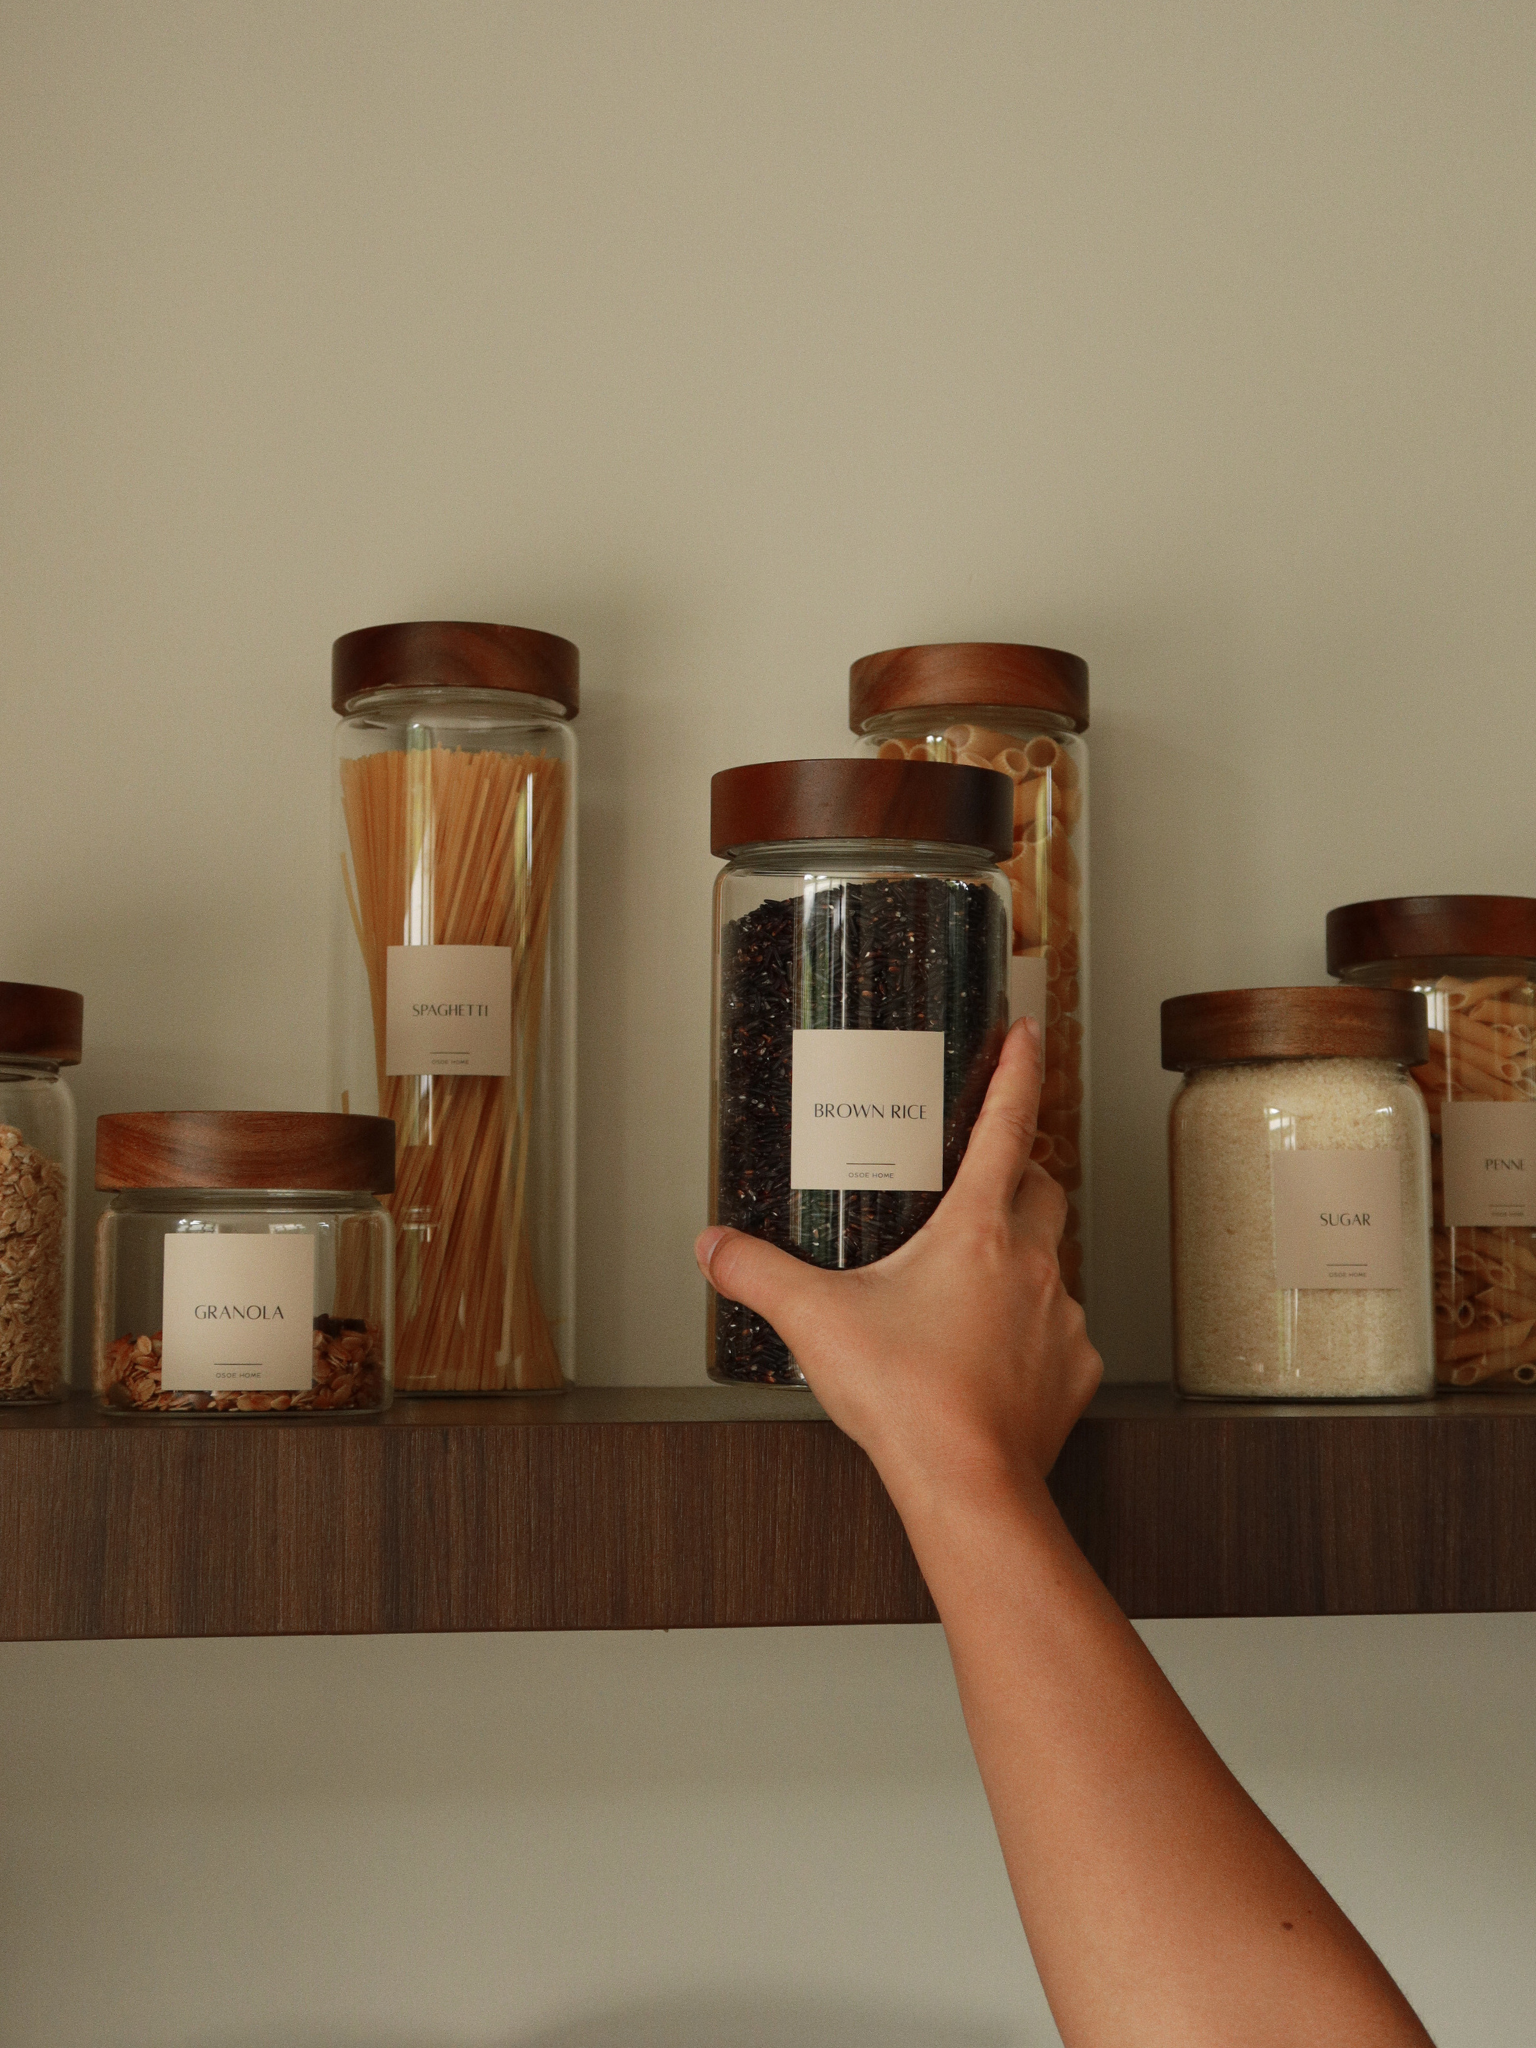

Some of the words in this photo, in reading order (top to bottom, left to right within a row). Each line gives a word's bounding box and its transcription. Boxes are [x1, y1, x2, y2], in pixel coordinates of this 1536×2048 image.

[412, 1003, 489, 1017] SPAGHETTI
[814, 1103, 885, 1119] BROWN
[891, 1104, 927, 1120] RICE
[1319, 1212, 1371, 1227] SUGAR
[194, 1304, 285, 1320] GRANOLA
